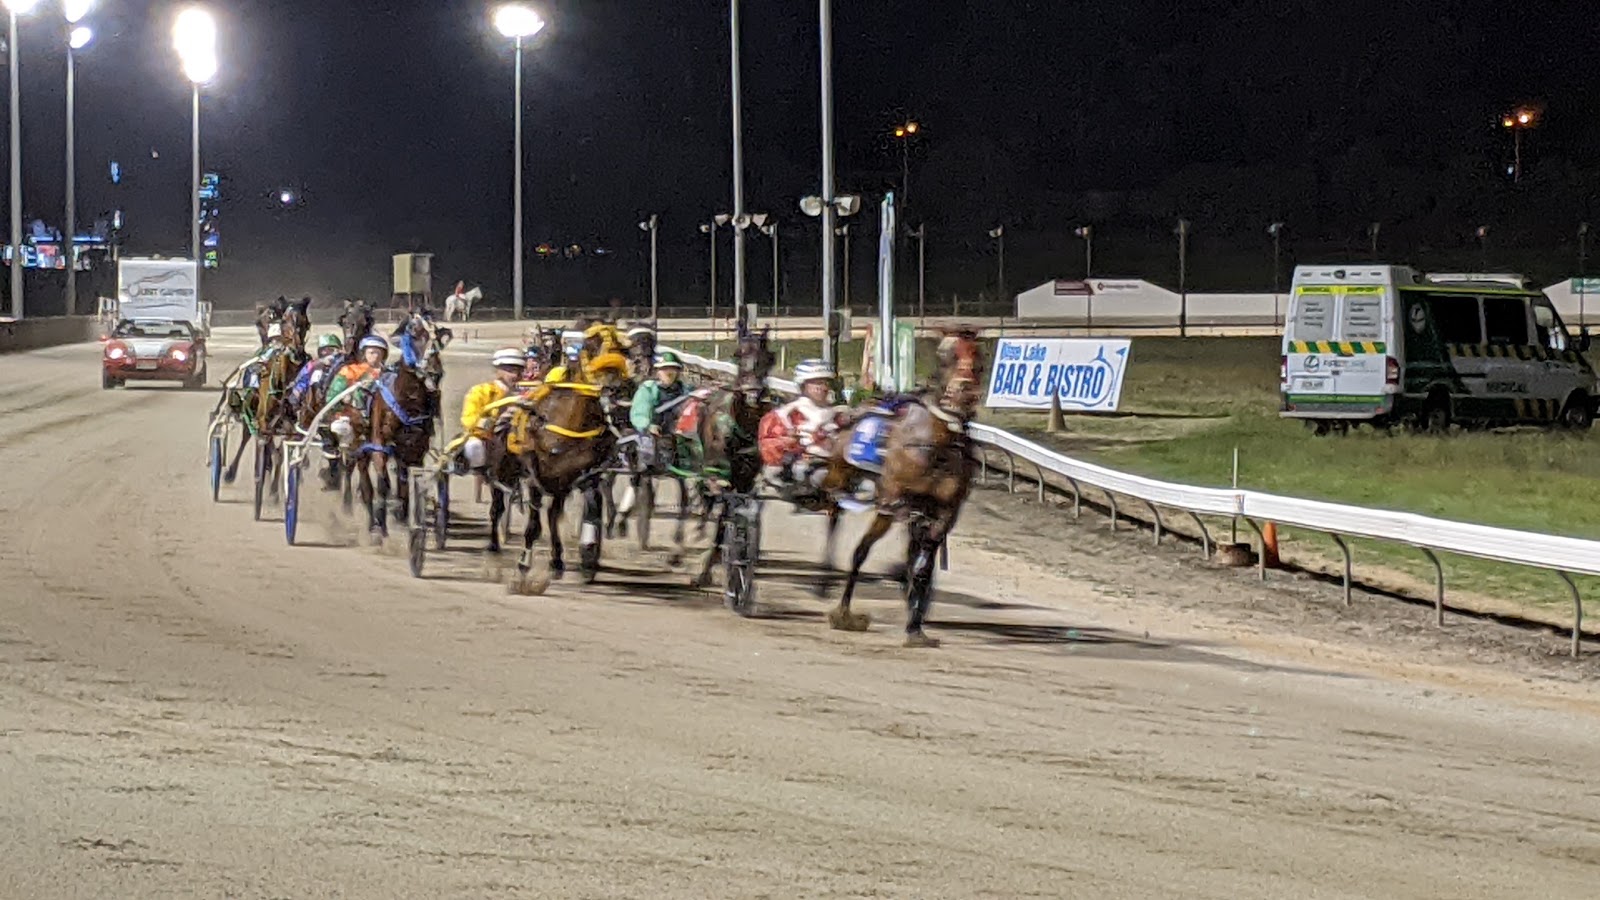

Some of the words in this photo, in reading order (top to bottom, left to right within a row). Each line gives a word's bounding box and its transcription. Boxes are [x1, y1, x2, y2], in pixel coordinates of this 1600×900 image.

[1023, 343, 1047, 361] Lake
[993, 363, 1027, 396] BAR
[1028, 363, 1042, 397] &
[1045, 364, 1105, 399] BISTRO
